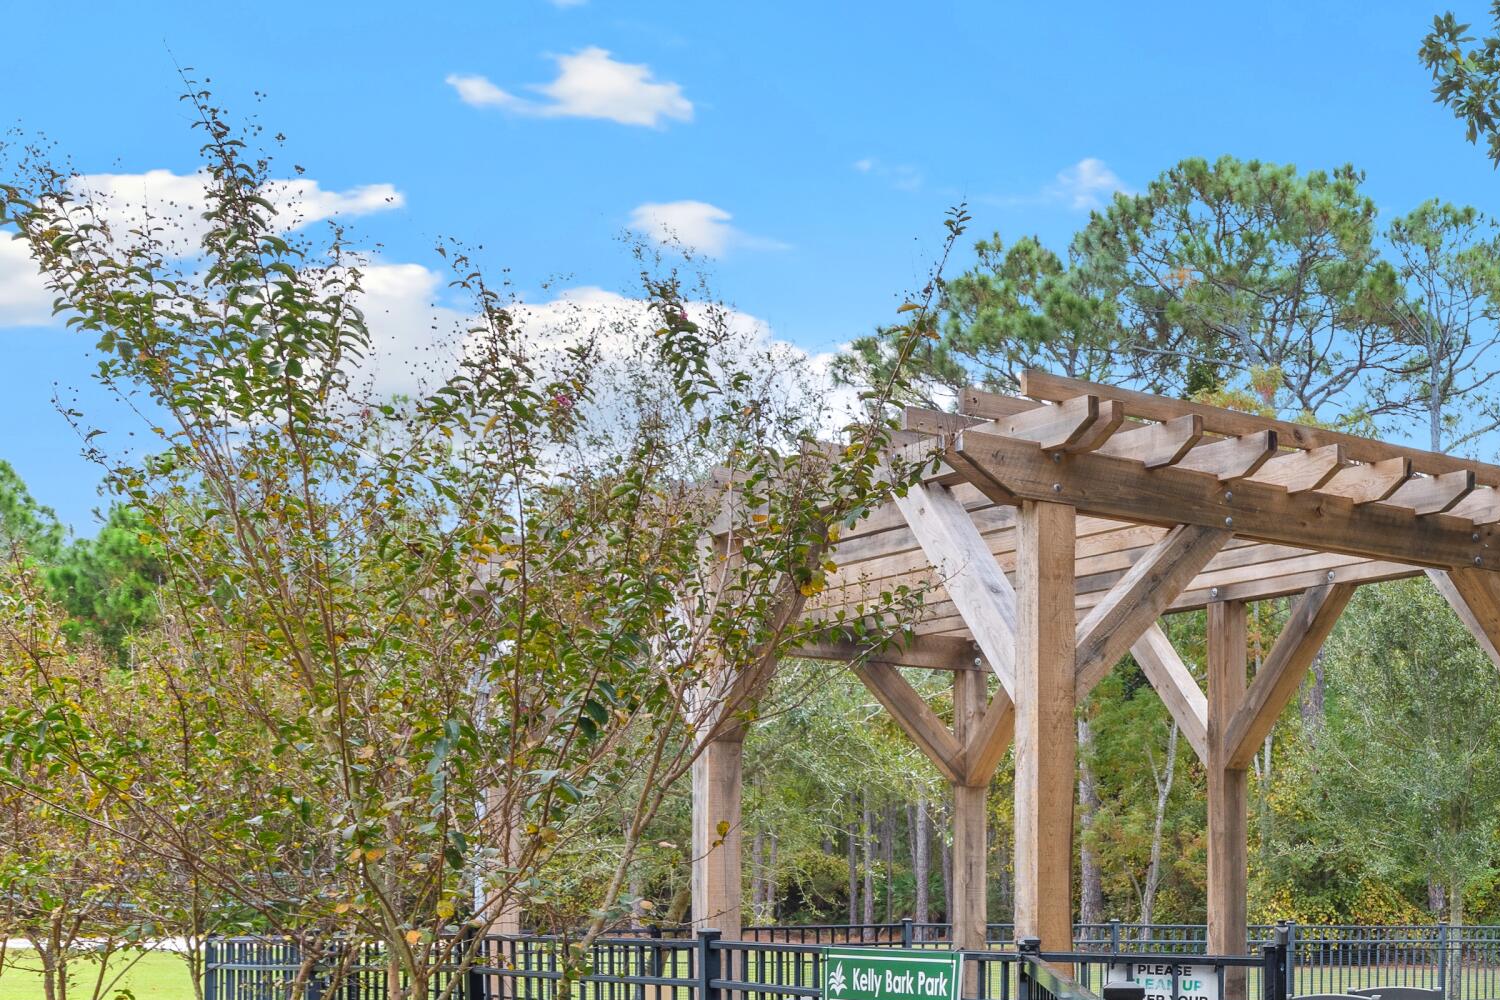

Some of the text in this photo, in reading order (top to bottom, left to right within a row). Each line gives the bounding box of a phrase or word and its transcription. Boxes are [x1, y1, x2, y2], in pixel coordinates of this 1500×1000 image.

[1138, 965, 1192, 976] PLEASE
[853, 968, 948, 997] Kelly Bark Park
[1135, 978, 1202, 991] LEAN UP
